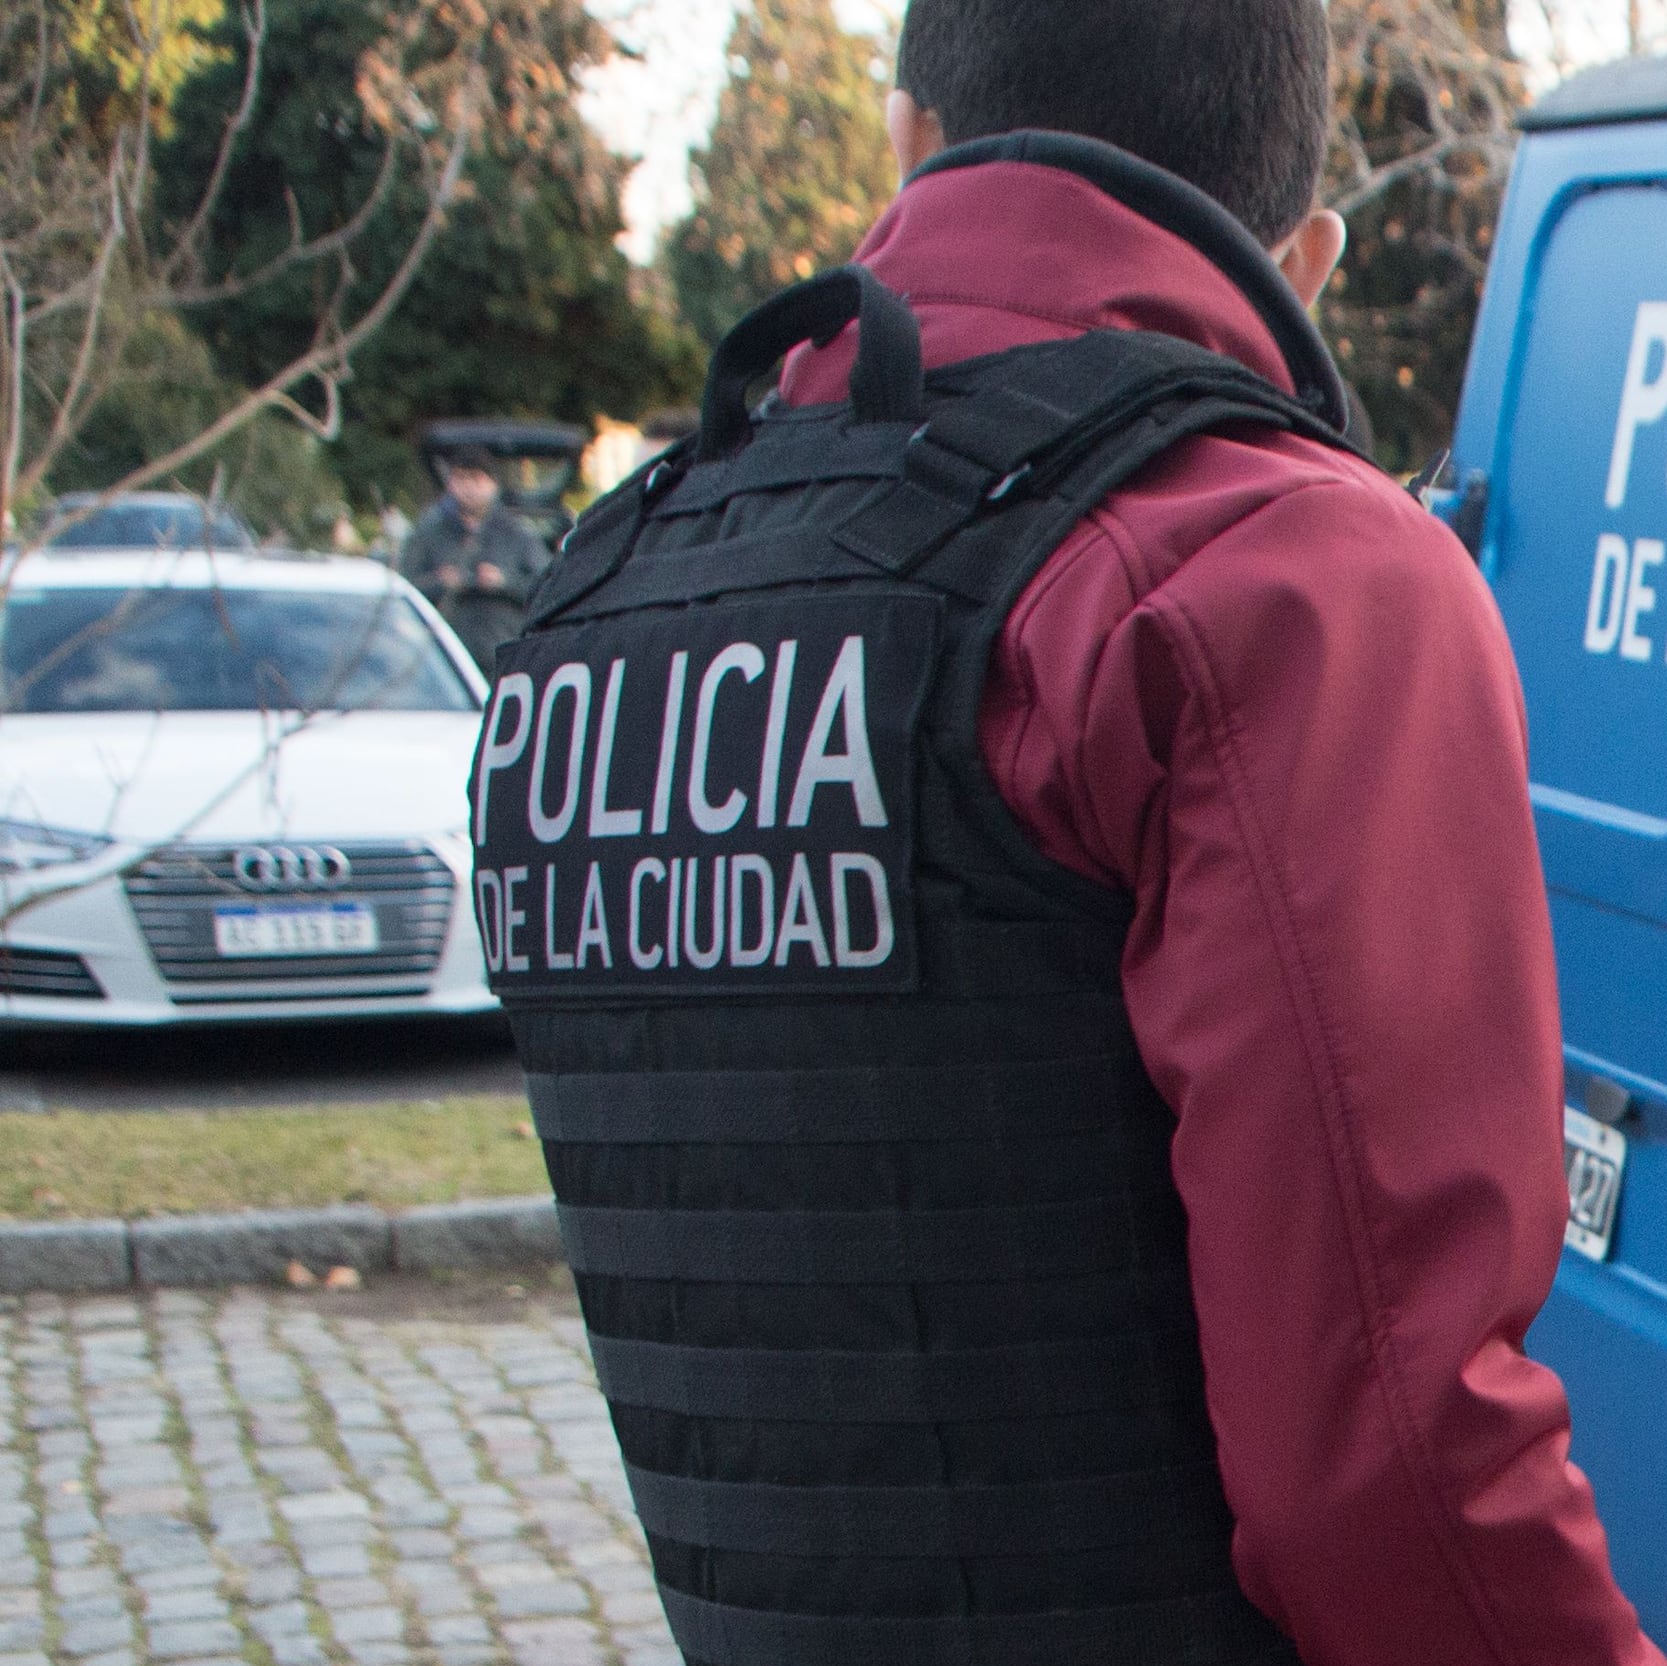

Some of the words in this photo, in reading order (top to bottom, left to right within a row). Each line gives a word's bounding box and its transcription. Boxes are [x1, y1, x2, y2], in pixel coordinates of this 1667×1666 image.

[1584, 533, 1665, 662] DE
[474, 634, 889, 848] POLICIA
[474, 866, 531, 973] DE
[544, 860, 614, 970] LA
[628, 851, 895, 970] CIUDAD
